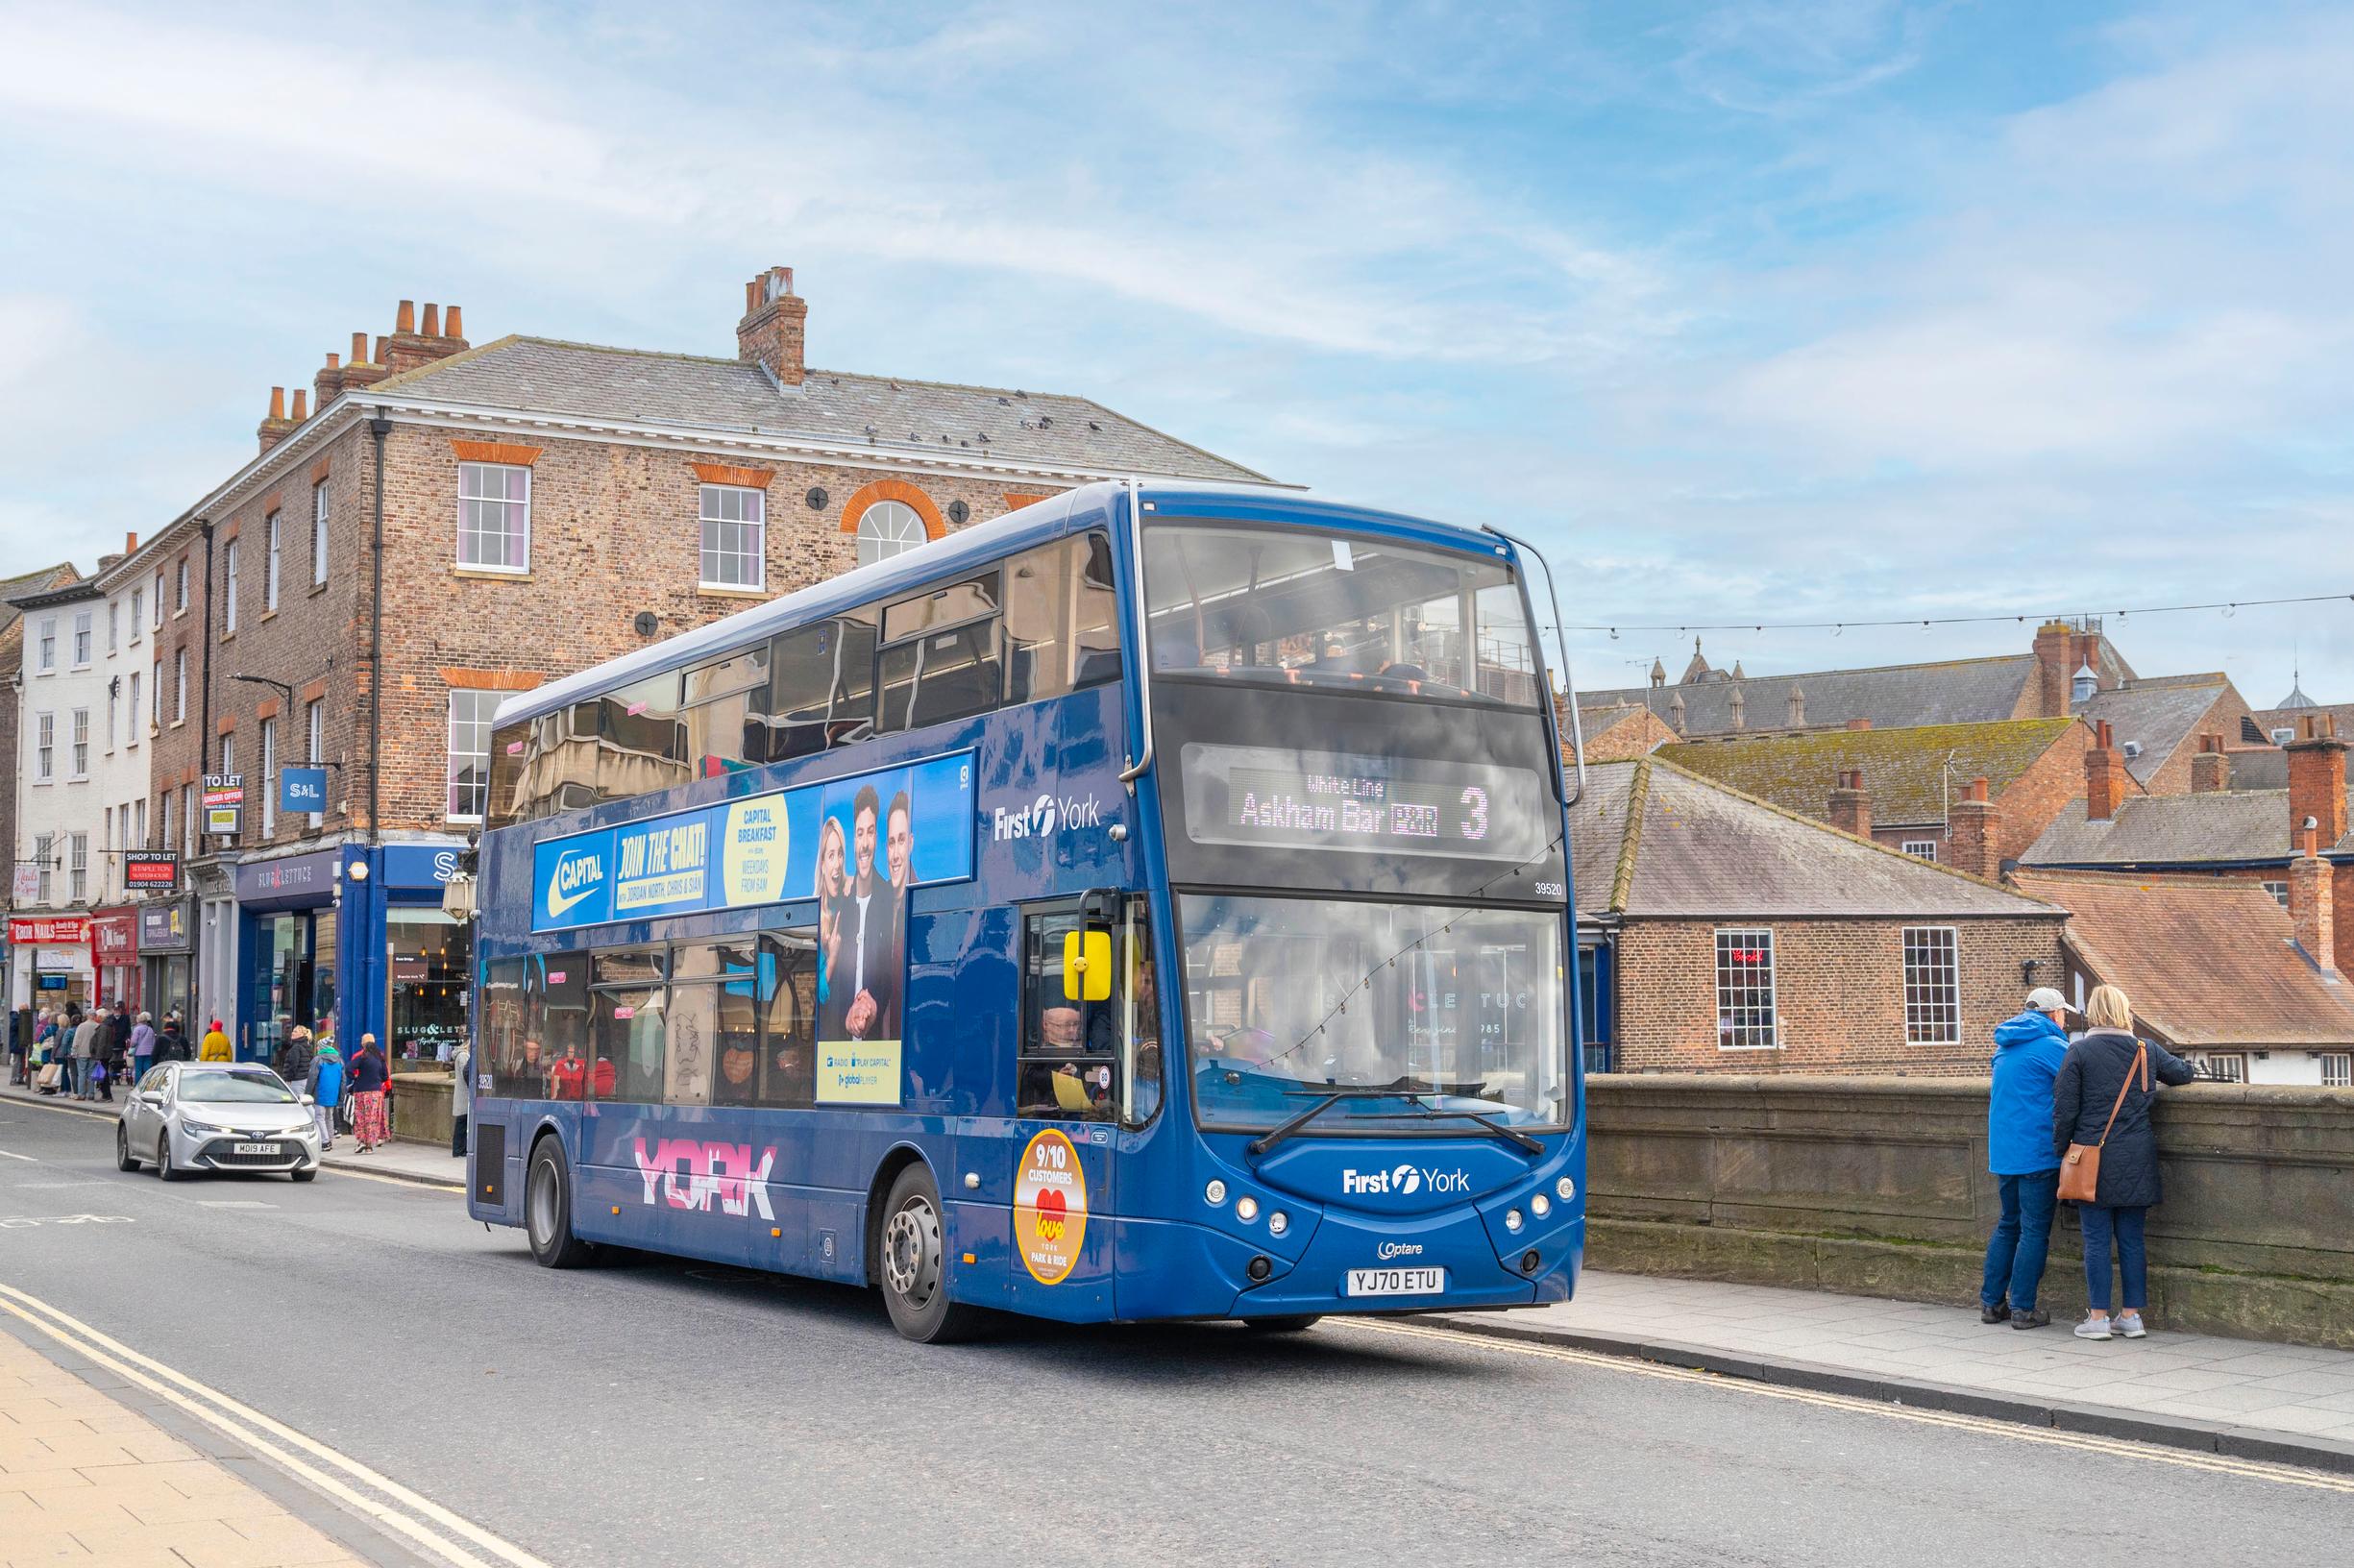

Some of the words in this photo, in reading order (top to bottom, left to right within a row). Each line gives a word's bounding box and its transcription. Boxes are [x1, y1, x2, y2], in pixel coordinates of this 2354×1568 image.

[205, 775, 221, 787] TO
[224, 775, 241, 786] LET
[1308, 774, 1347, 795] White
[1354, 775, 1384, 797] Line
[204, 794, 223, 803] UNDER
[224, 791, 242, 800] OFFER
[744, 808, 772, 824] CAPITAL
[994, 805, 1030, 841] First
[1058, 792, 1100, 831] York
[1240, 794, 1335, 832] Askham
[1342, 799, 1385, 833] Bar
[1459, 786, 1488, 840] 3
[738, 826, 776, 843] BREAKFAST
[618, 833, 647, 880] JOIN
[648, 829, 670, 874] THE
[670, 821, 706, 870] CHAT!
[560, 854, 603, 892] CAPITAL
[742, 859, 769, 874] WEEKDAYS
[16, 868, 37, 884] Nails
[741, 878, 755, 893] FROM
[1535, 882, 1562, 896] 39520
[34, 923, 55, 939] NAILS
[239, 1144, 257, 1153] MD19
[260, 1144, 275, 1153] AFE
[1036, 1143, 1066, 1169] 9/10
[634, 1138, 777, 1221] YORK
[1028, 1168, 1072, 1185] CUSTOMERS
[1343, 1169, 1389, 1193] First
[1422, 1168, 1470, 1192] York
[1036, 1210, 1065, 1239] love
[1031, 1251, 1046, 1263] PARK
[1047, 1253, 1053, 1264] &
[1053, 1254, 1067, 1267] RIDE
[1385, 1242, 1423, 1259] Optare
[1356, 1272, 1399, 1291] YJ70
[1405, 1270, 1436, 1289] ETU
